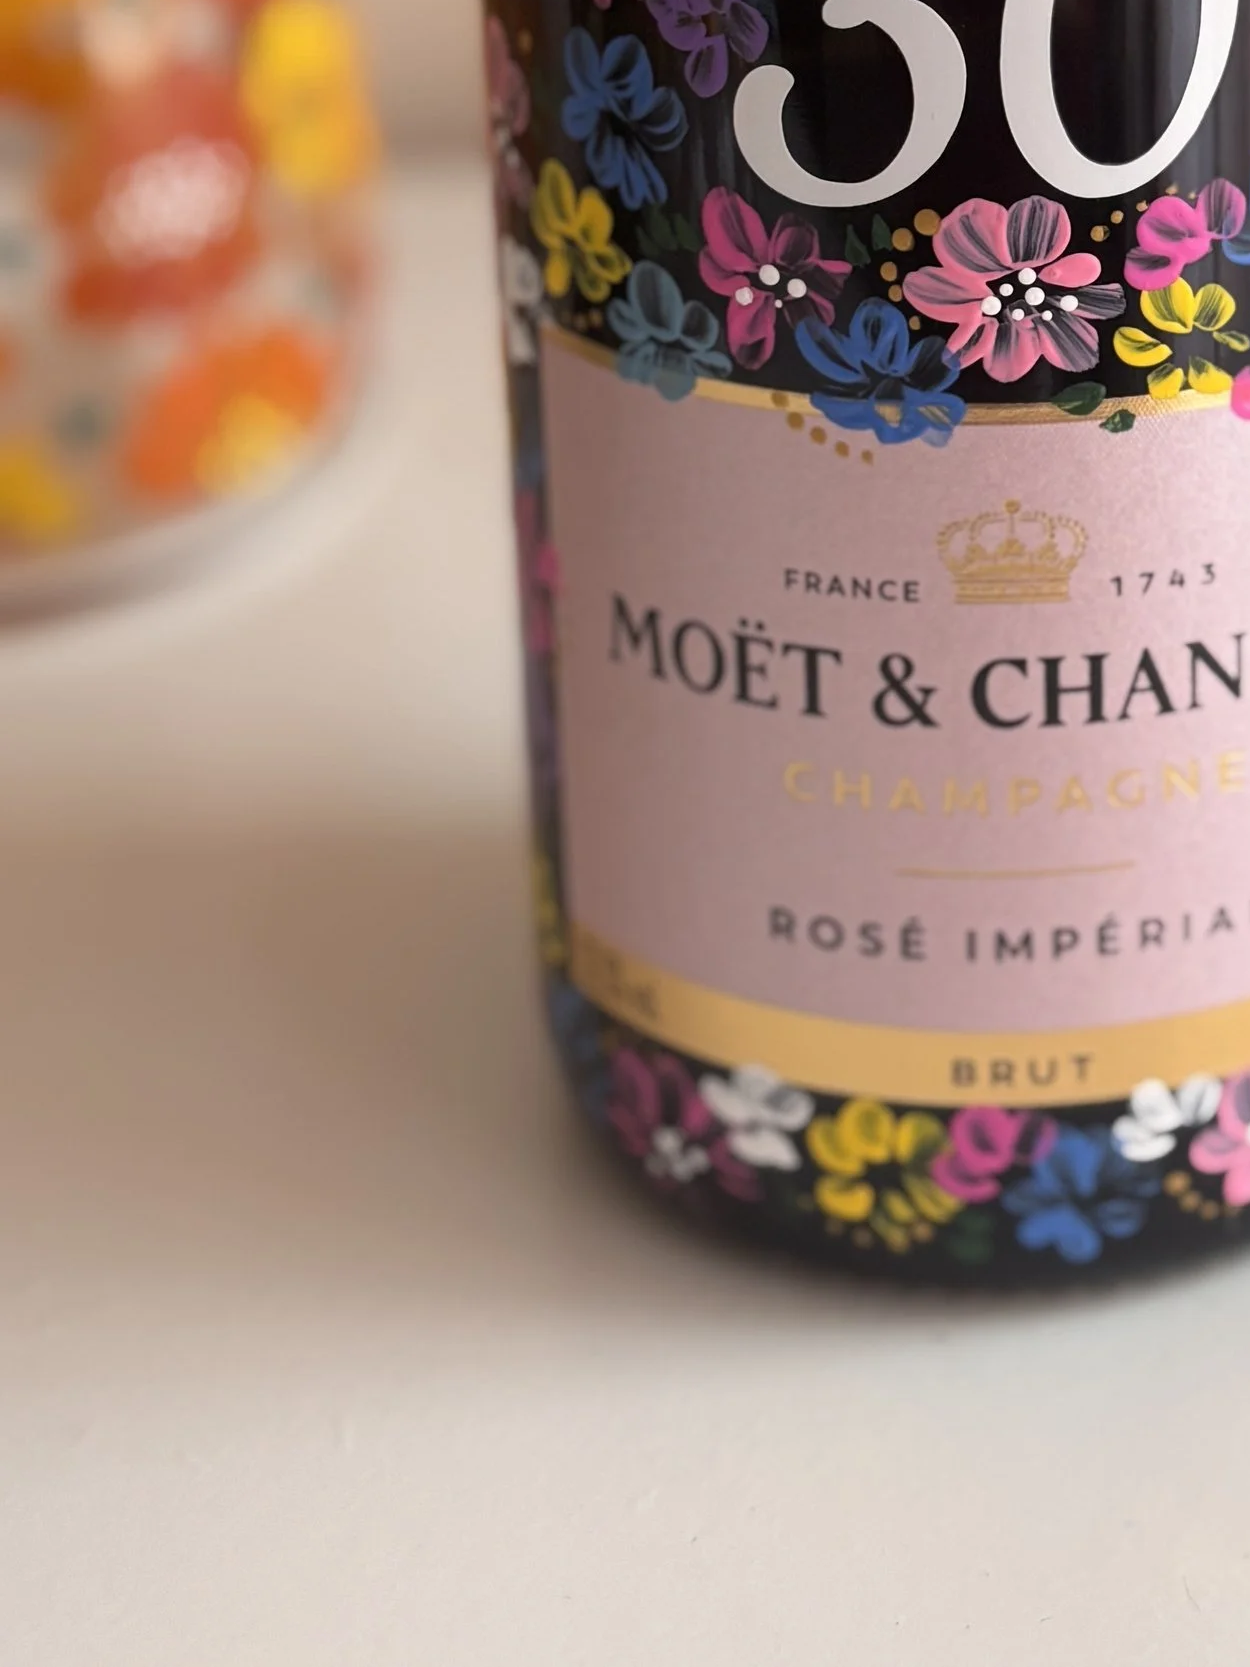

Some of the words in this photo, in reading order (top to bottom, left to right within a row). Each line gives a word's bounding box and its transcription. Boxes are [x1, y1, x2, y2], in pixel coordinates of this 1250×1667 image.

[783, 568, 921, 603] FRANCE
[1109, 563, 1216, 597] 1743
[609, 590, 843, 718] MOËT
[871, 652, 941, 729] &
[783, 749, 1247, 817] CHAMPAGNE
[767, 905, 928, 961] ROSÉ
[950, 1054, 1096, 1089] BRUT
